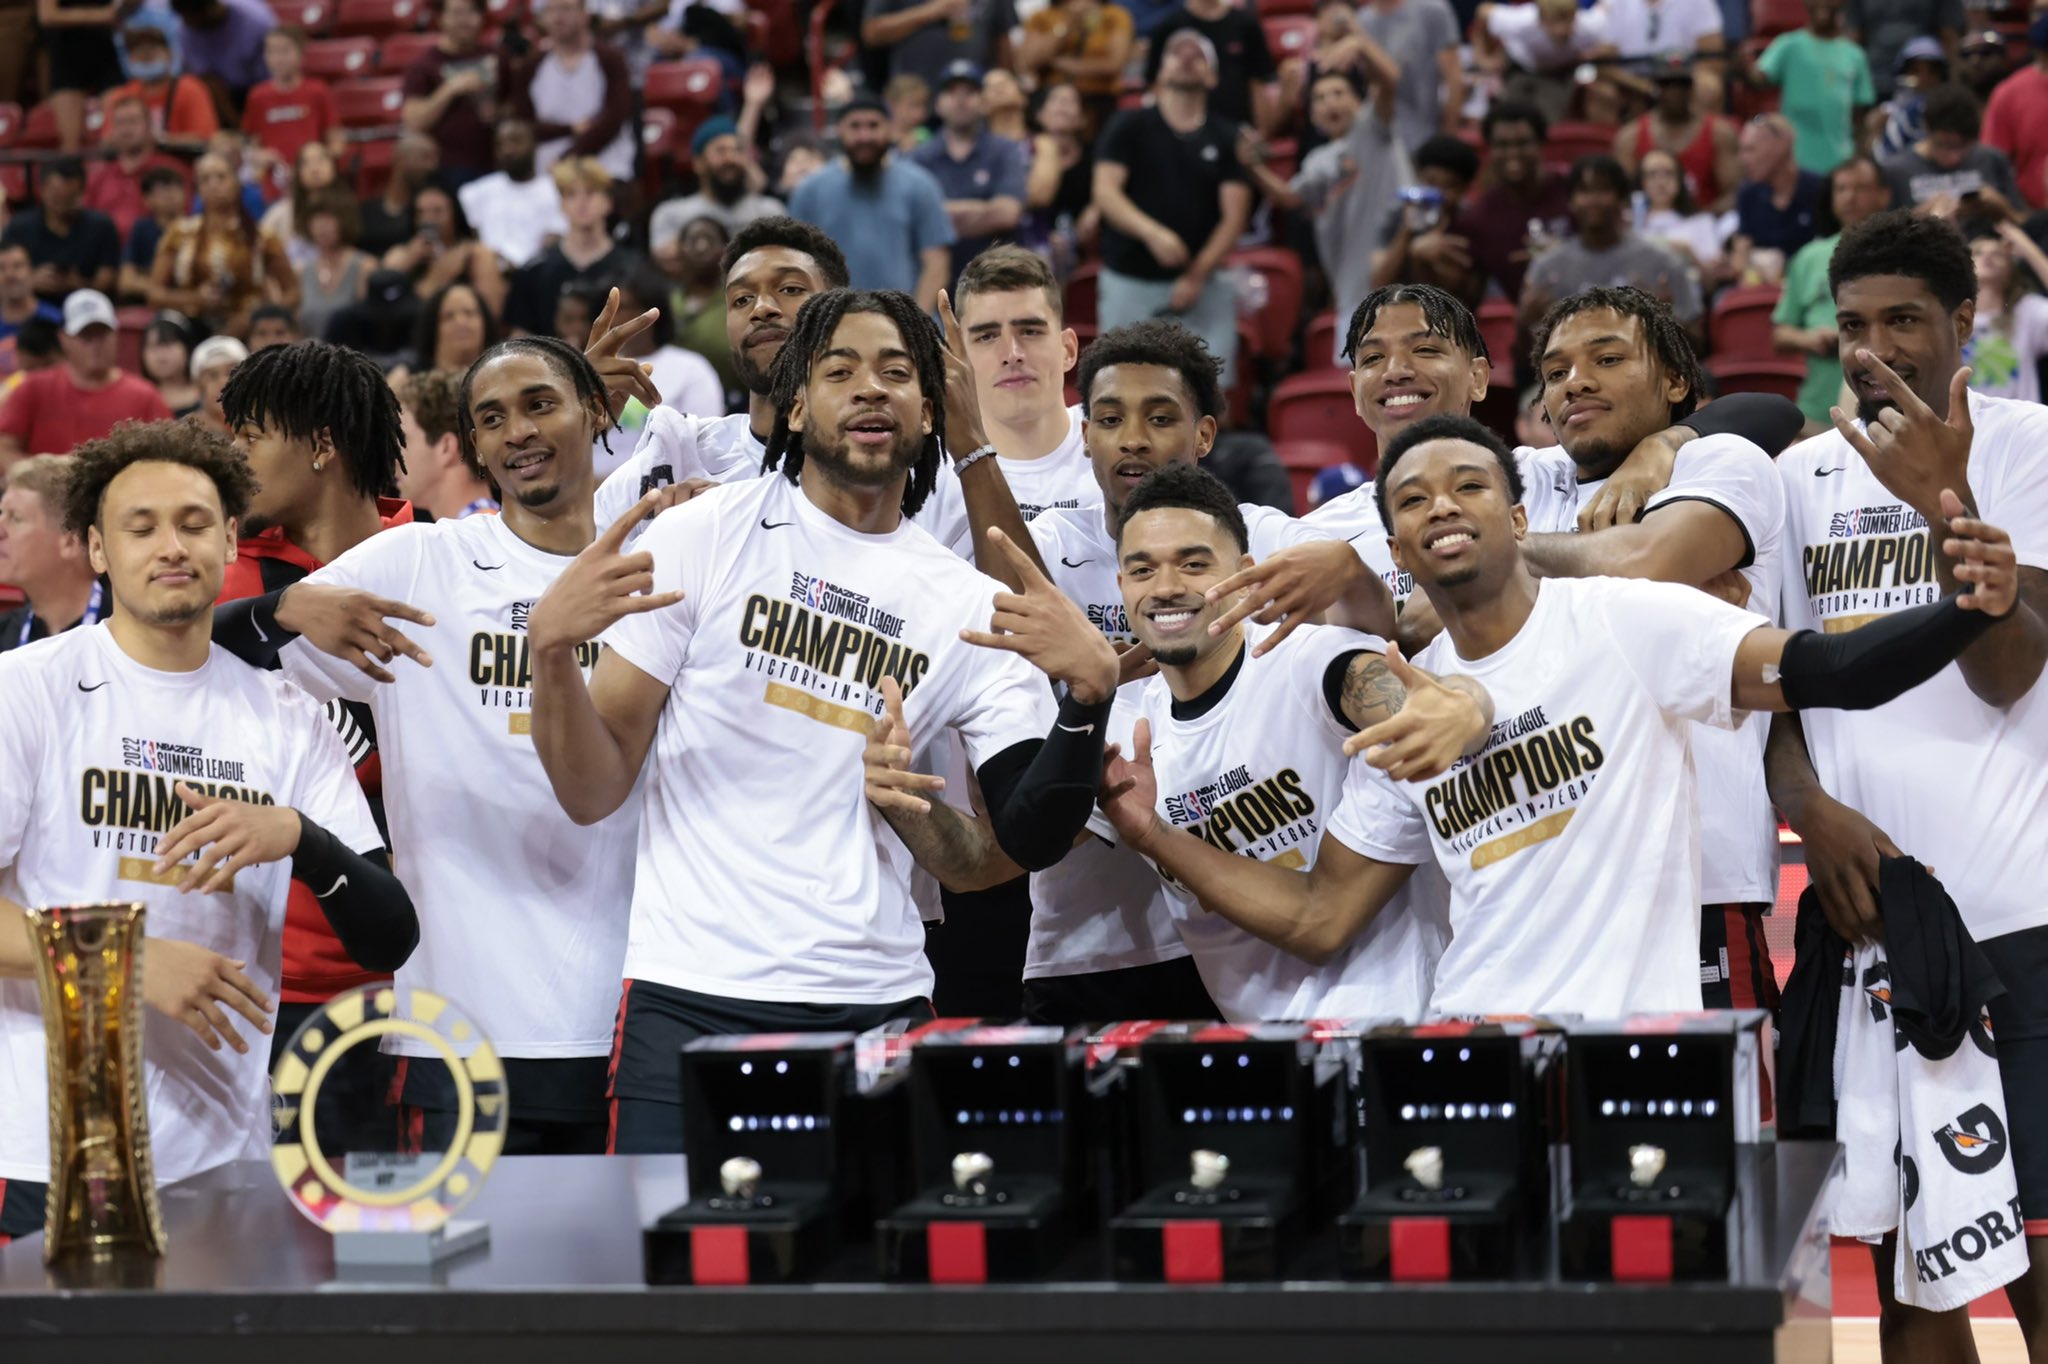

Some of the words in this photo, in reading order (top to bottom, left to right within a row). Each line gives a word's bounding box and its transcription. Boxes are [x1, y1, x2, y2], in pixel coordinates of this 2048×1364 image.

[1829, 512, 1849, 538] 2022
[1856, 514, 1901, 535] SUMMER
[1901, 511, 1929, 531] LEAG
[1803, 532, 1937, 599] CHAMPIO
[790, 571, 810, 604] 2022
[825, 582, 870, 604] NBA2K23
[1874, 591, 1891, 609] IN
[1905, 587, 1942, 606] VEG
[511, 602, 530, 631] 2022
[820, 592, 868, 626] SUMMER
[868, 607, 906, 639] LEAGUE
[739, 593, 930, 703] CHAMPIONS
[745, 651, 819, 691] VICTORY
[831, 682, 851, 702] IN
[481, 689, 532, 708] VICT
[1508, 705, 1550, 740] LEAGUE
[122, 737, 142, 768] 2022
[156, 742, 203, 756] NBA2K23
[157, 751, 205, 778] SUMMER
[206, 758, 246, 783] LEAGUE
[1425, 715, 1604, 840] CHAMPIONS
[1165, 795, 1189, 825] 2022
[1517, 802, 1537, 823] IN
[1548, 774, 1596, 810] VEGA
[93, 830, 159, 855] VICTOR
[1267, 818, 1318, 851] VEGAS
